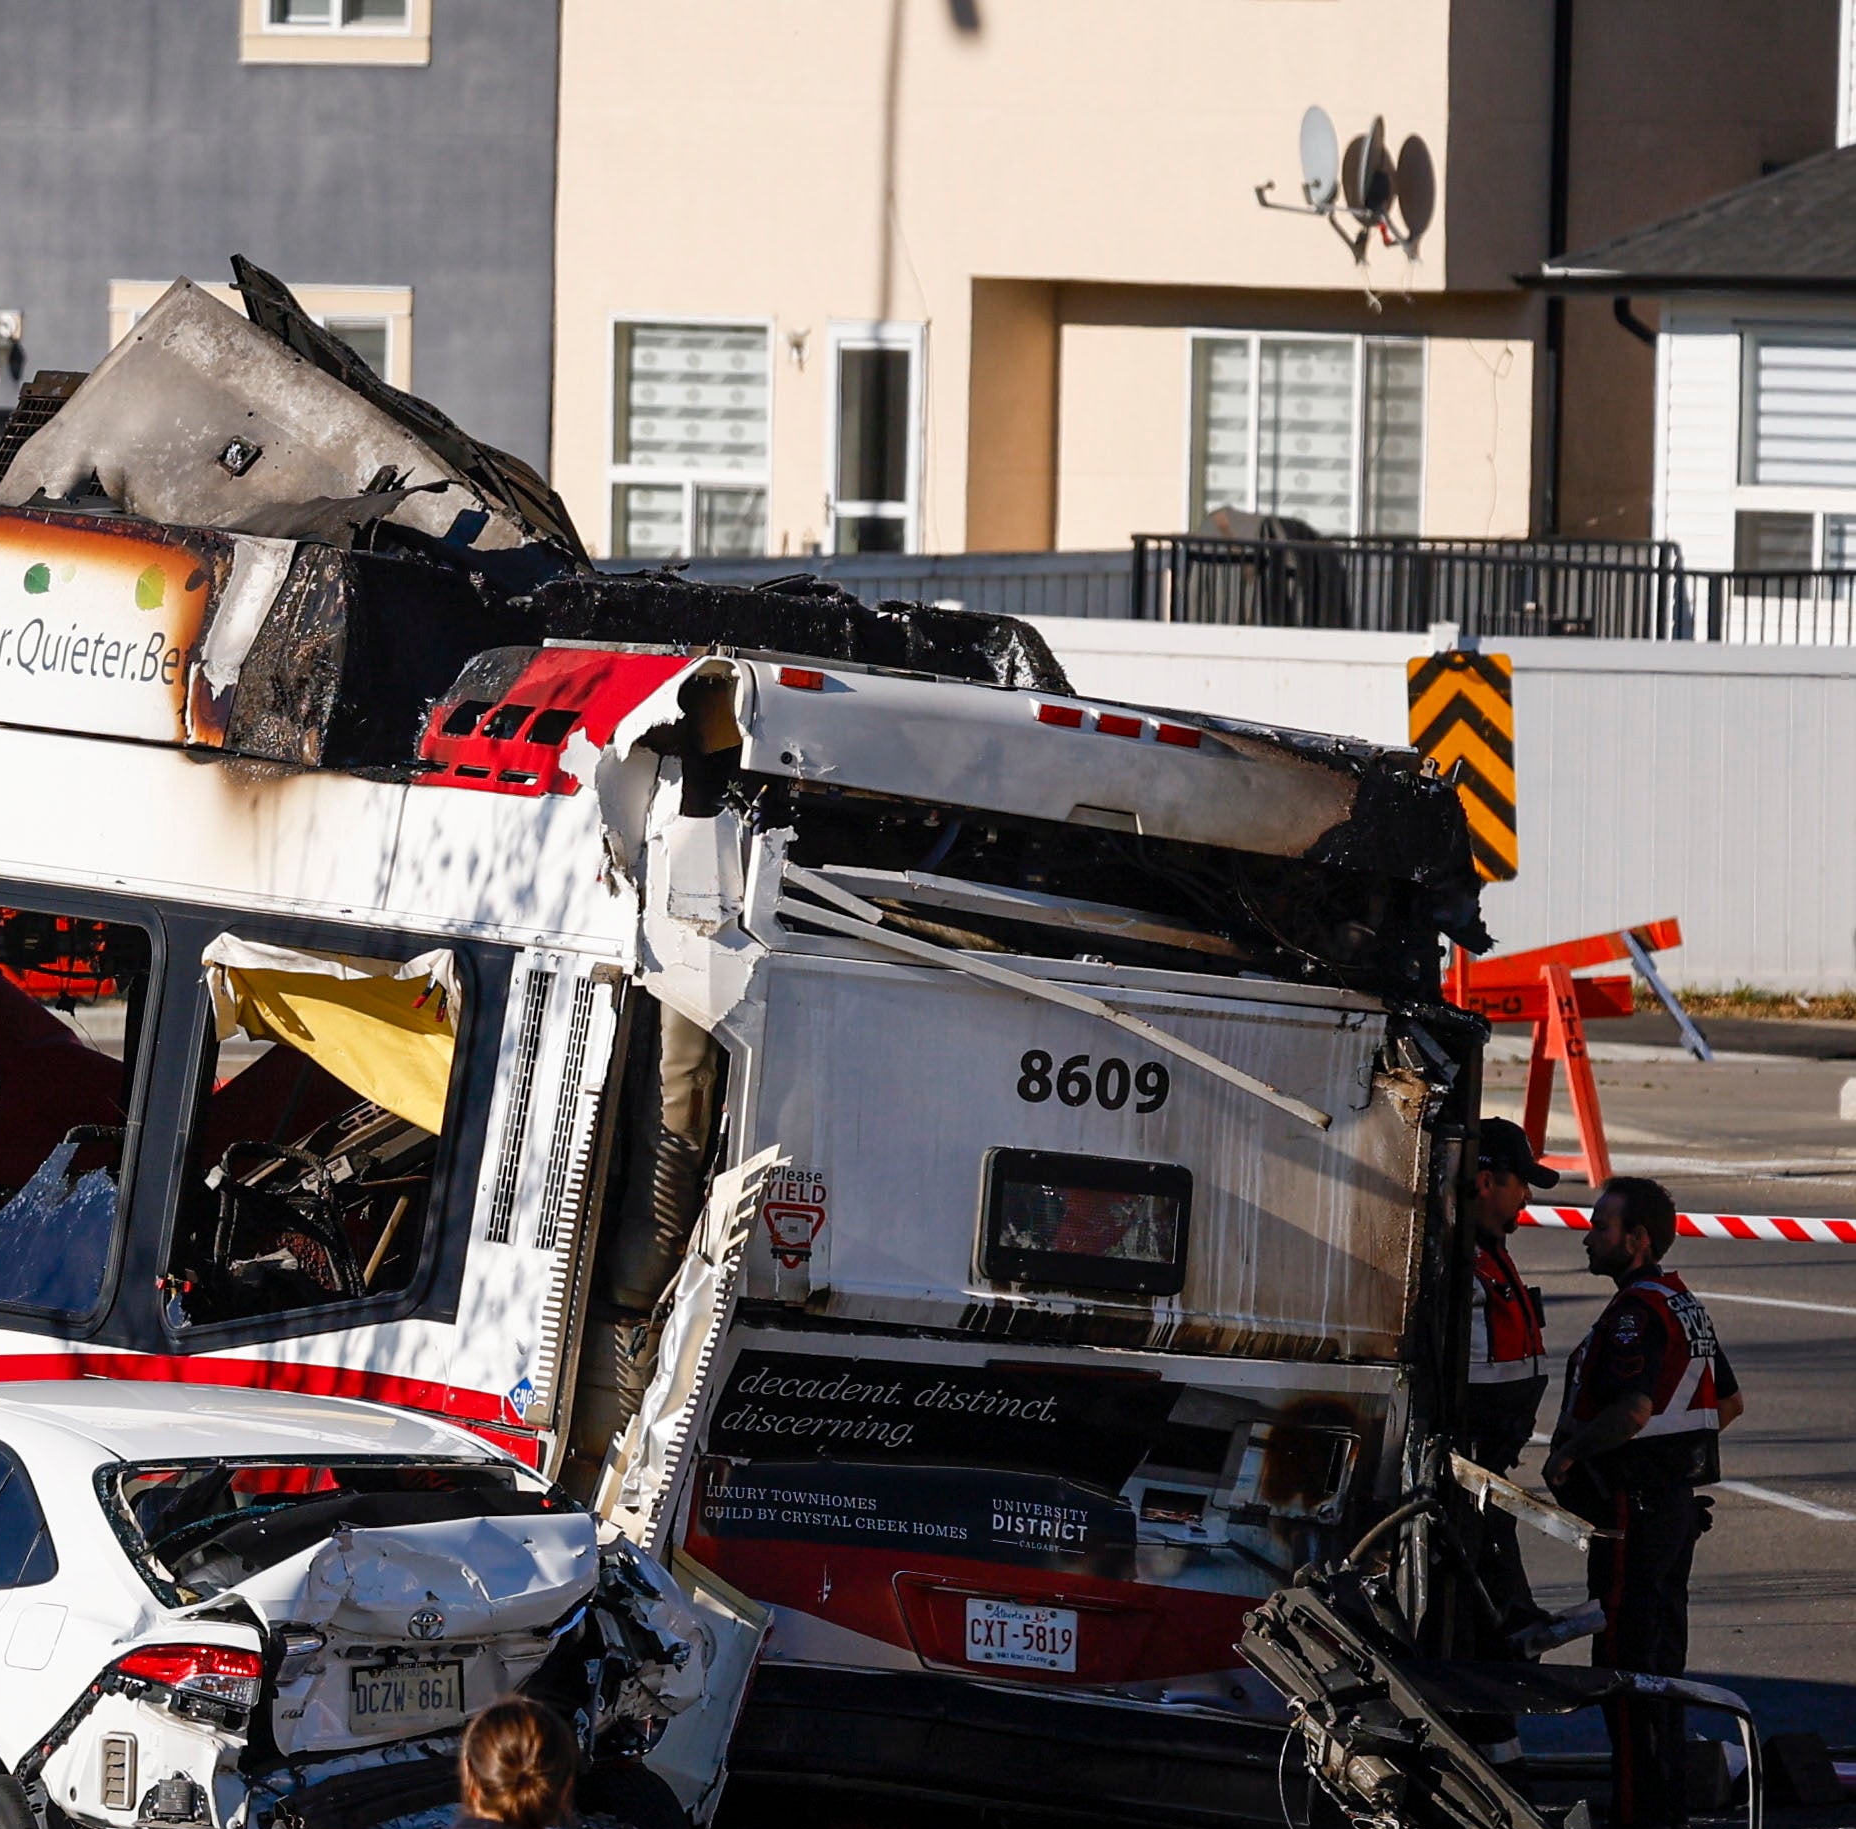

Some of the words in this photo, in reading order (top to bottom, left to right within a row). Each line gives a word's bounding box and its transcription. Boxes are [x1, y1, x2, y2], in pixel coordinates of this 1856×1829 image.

[1017, 1049, 1170, 1114] 8609
[771, 1166, 823, 1184] Please
[766, 1181, 827, 1204] YIELD
[738, 1367, 902, 1405] decadent.
[913, 1381, 1058, 1423] distinct.
[720, 1404, 914, 1448] discerning.
[706, 1485, 767, 1501] LUXURY
[771, 1489, 877, 1511] TOWNHOMES
[992, 1498, 1088, 1522] UNIVERSITY
[704, 1505, 753, 1520] GUILD
[758, 1508, 778, 1521] BY
[781, 1510, 852, 1528] CRYSTAL
[855, 1517, 909, 1533] CREEK
[912, 1522, 968, 1540] HOMES
[992, 1513, 1088, 1542] DISTRICT
[1018, 1539, 1061, 1553] CALGARY
[970, 1618, 1073, 1655] CXT-5819
[356, 1681, 406, 1715] DCZW
[418, 1678, 454, 1710] 861
